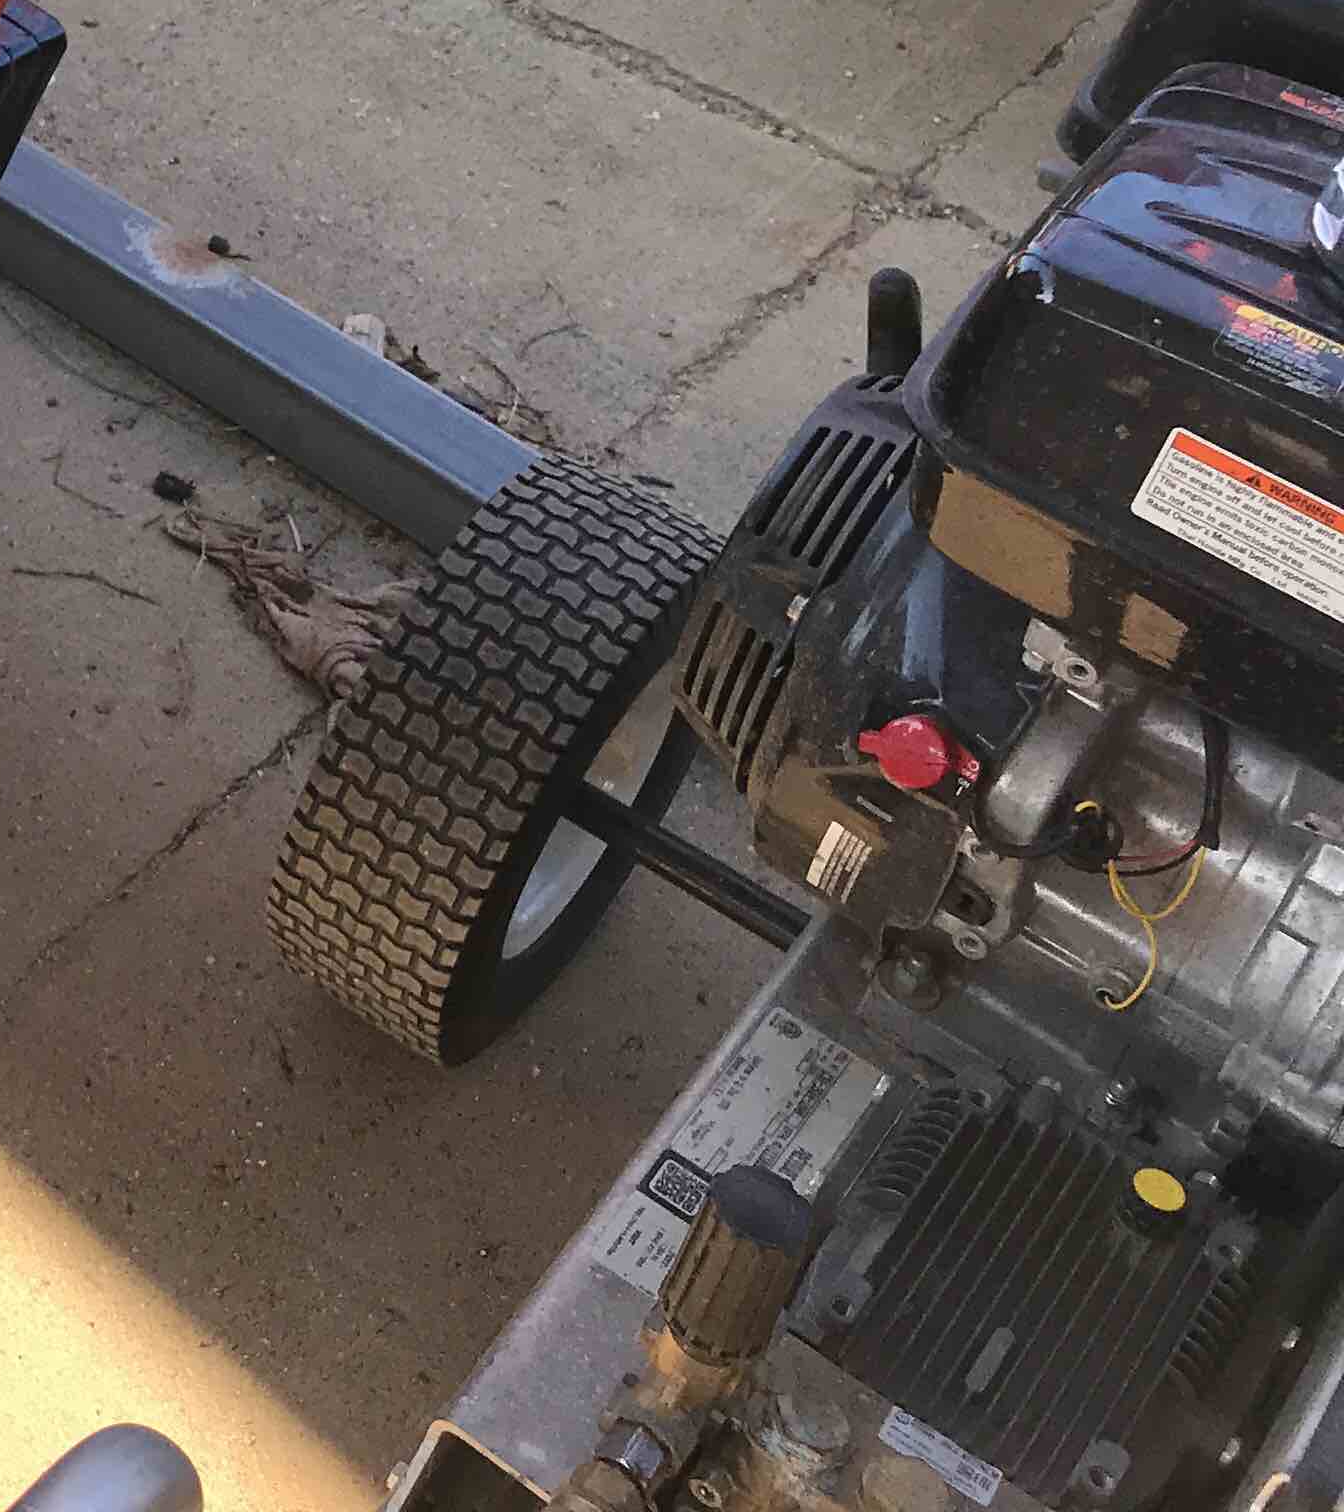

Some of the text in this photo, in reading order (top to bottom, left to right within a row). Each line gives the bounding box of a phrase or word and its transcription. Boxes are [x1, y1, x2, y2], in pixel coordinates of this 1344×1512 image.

[1267, 481, 1337, 525] WARNING
[1145, 495, 1172, 516] Read
[1171, 509, 1210, 536] Owner's
[1210, 530, 1248, 556] Manual
[1247, 550, 1280, 573] before
